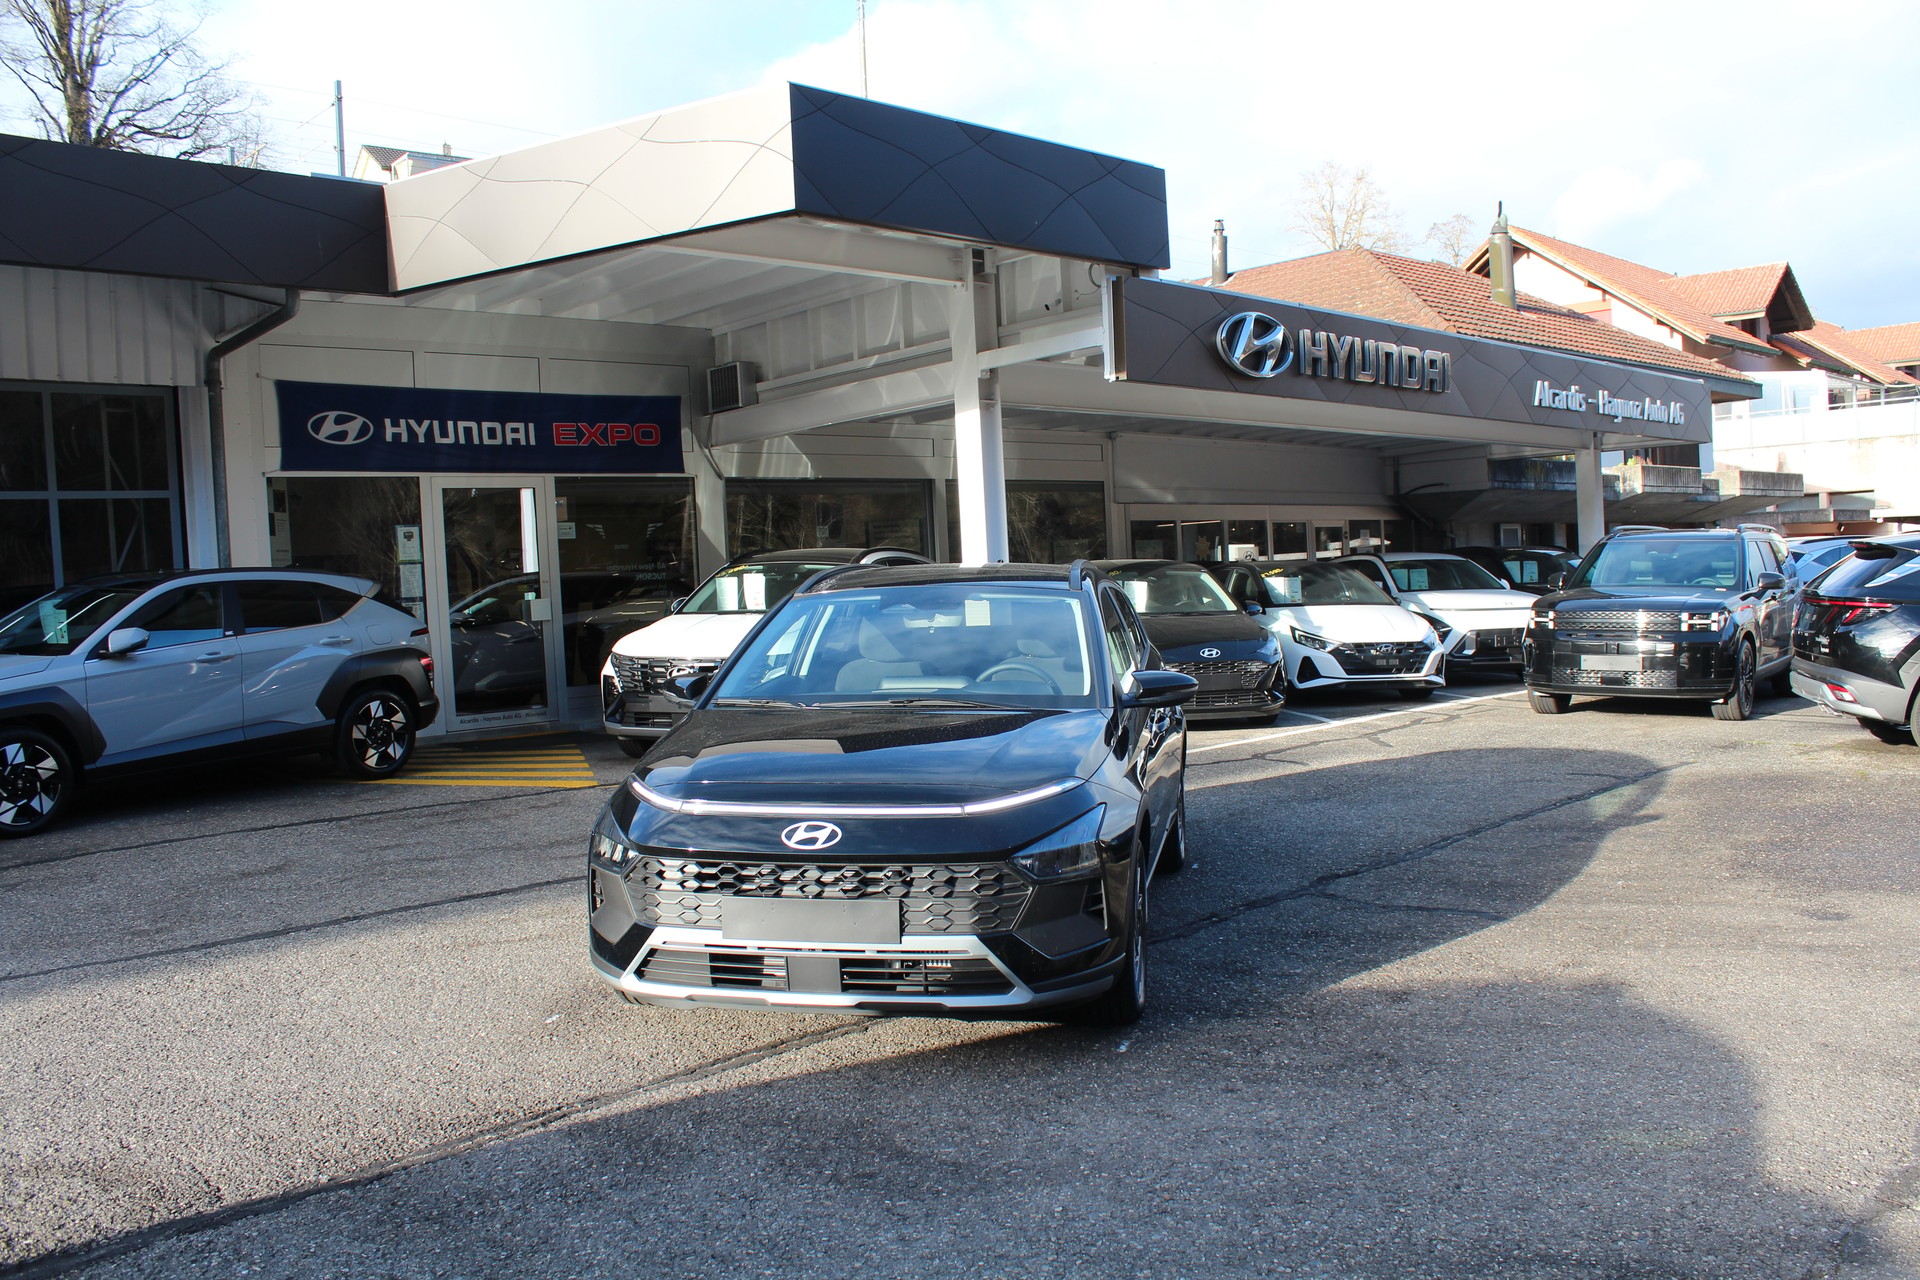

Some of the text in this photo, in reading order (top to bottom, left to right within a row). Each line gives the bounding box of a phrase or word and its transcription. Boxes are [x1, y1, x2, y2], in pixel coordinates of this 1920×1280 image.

[1299, 328, 1450, 393] HYUNDAI
[1533, 380, 1587, 412] Alcardis
[1598, 389, 1643, 423] Haymoz
[1643, 397, 1668, 423] Auto
[1668, 401, 1685, 424] AG
[384, 418, 661, 447] HYUNDAI EXPO
